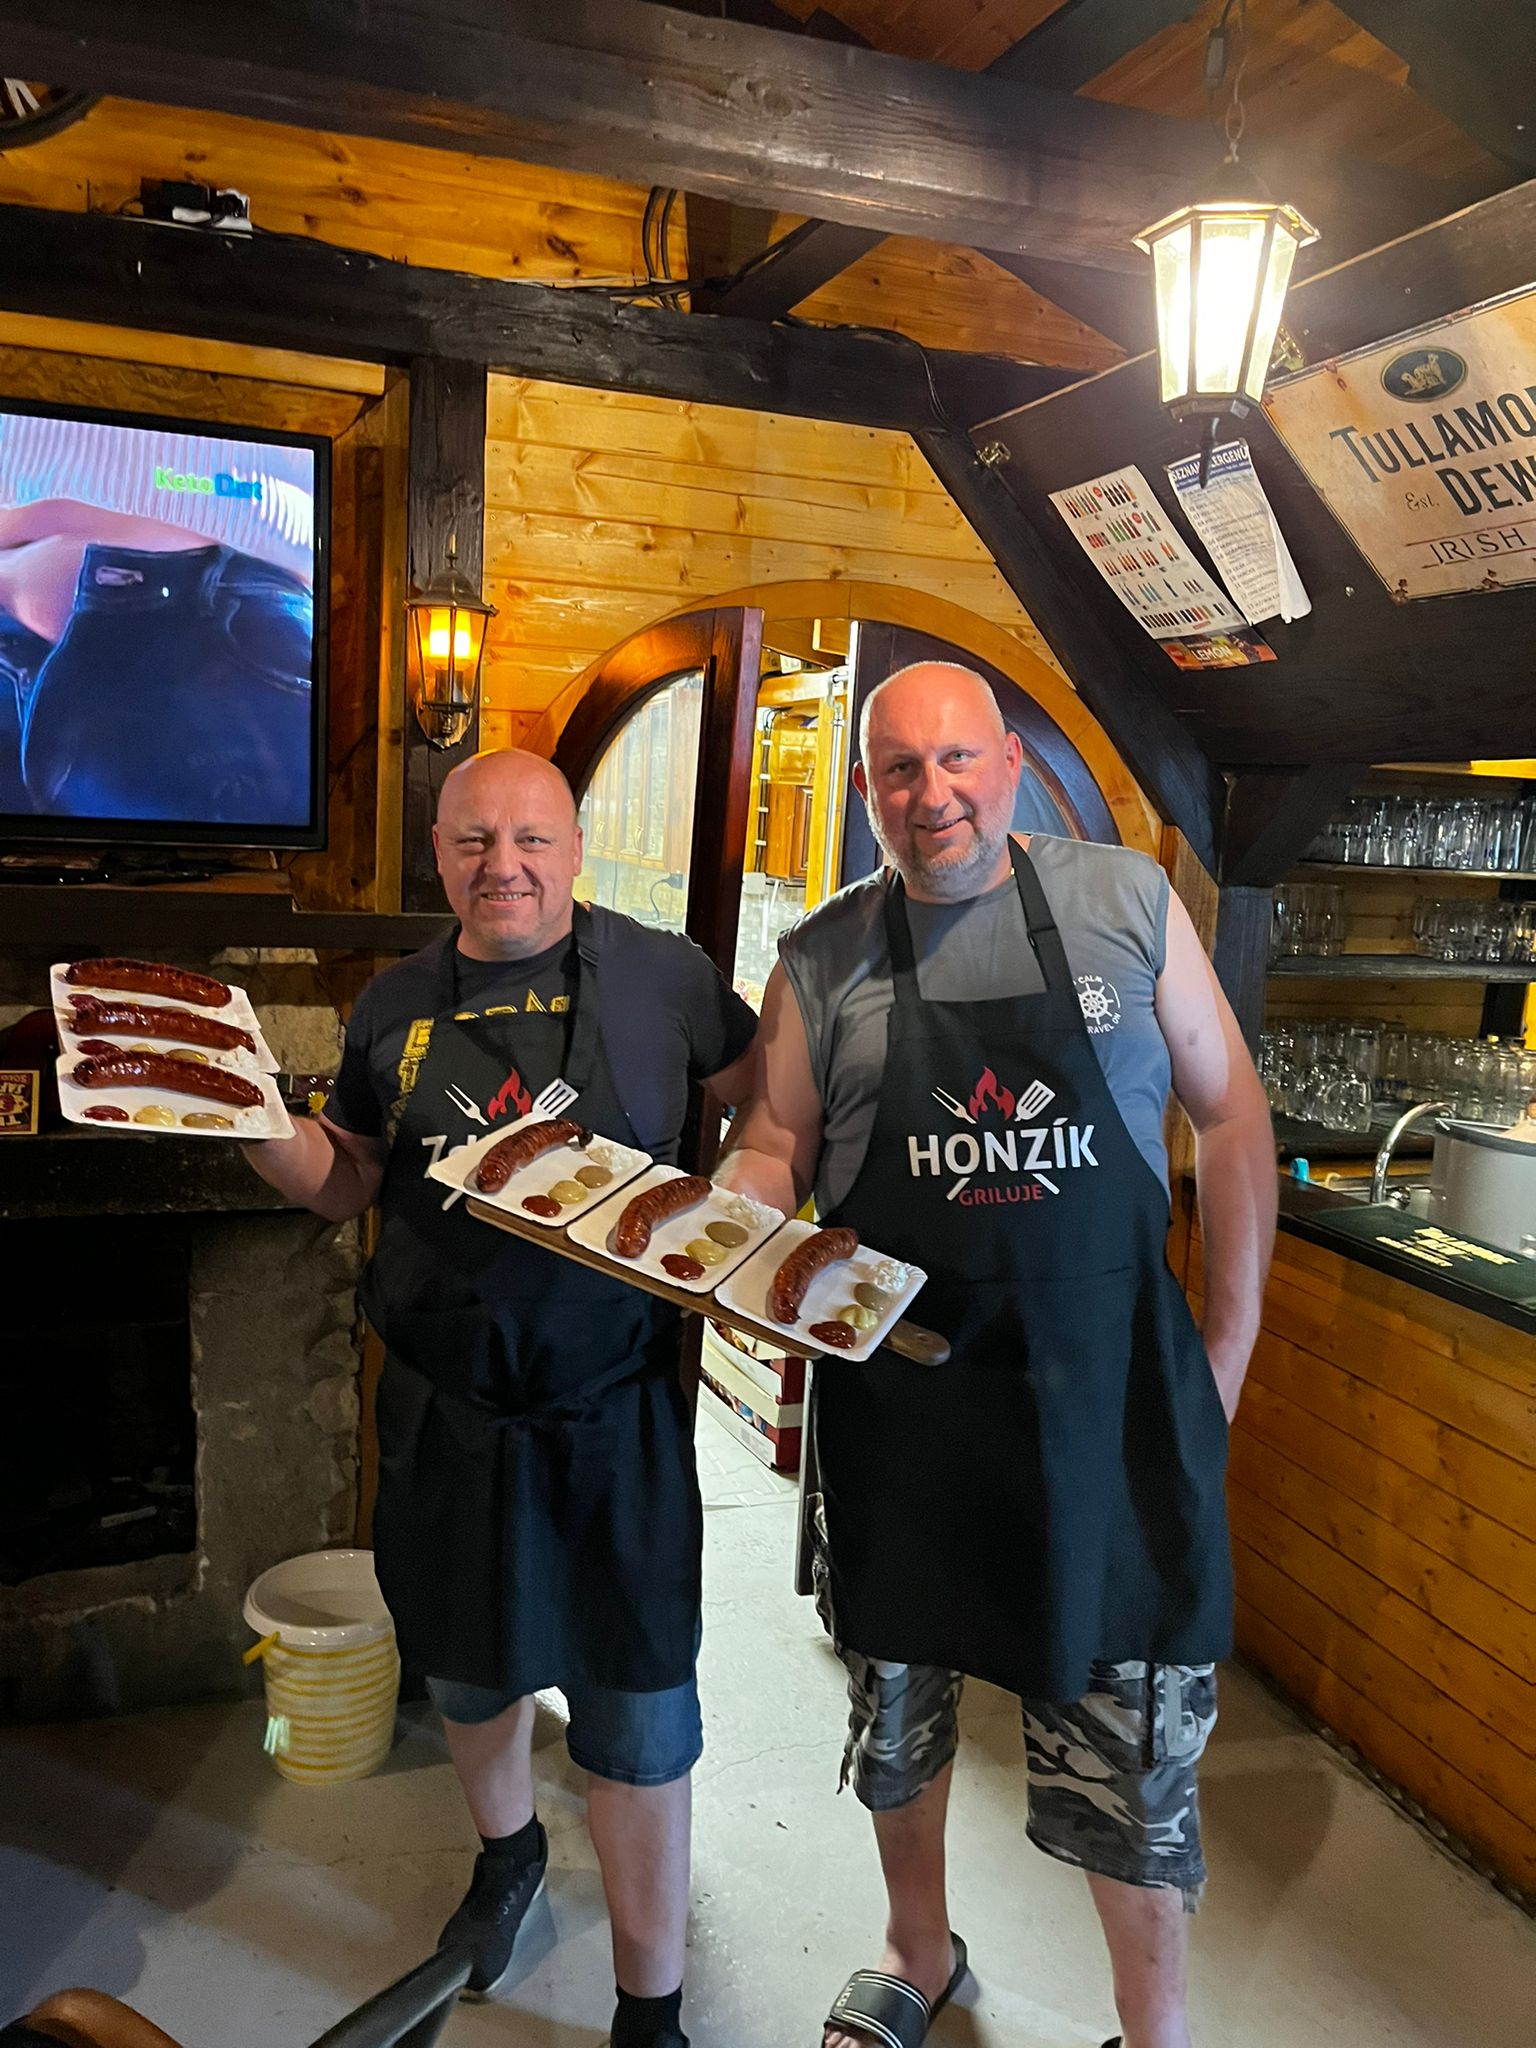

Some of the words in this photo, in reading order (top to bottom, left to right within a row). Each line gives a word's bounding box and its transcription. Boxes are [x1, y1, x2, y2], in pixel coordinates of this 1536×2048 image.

[1329, 386, 1536, 483] TULLAMO
[1404, 492, 1440, 511] Est.
[1430, 528, 1527, 564] IRISH
[1191, 645, 1234, 662] LEMON
[1087, 1023, 1115, 1034] RAVEL
[907, 1117, 1100, 1177] HONZÍK
[958, 1183, 1045, 1206] GRILUJE
